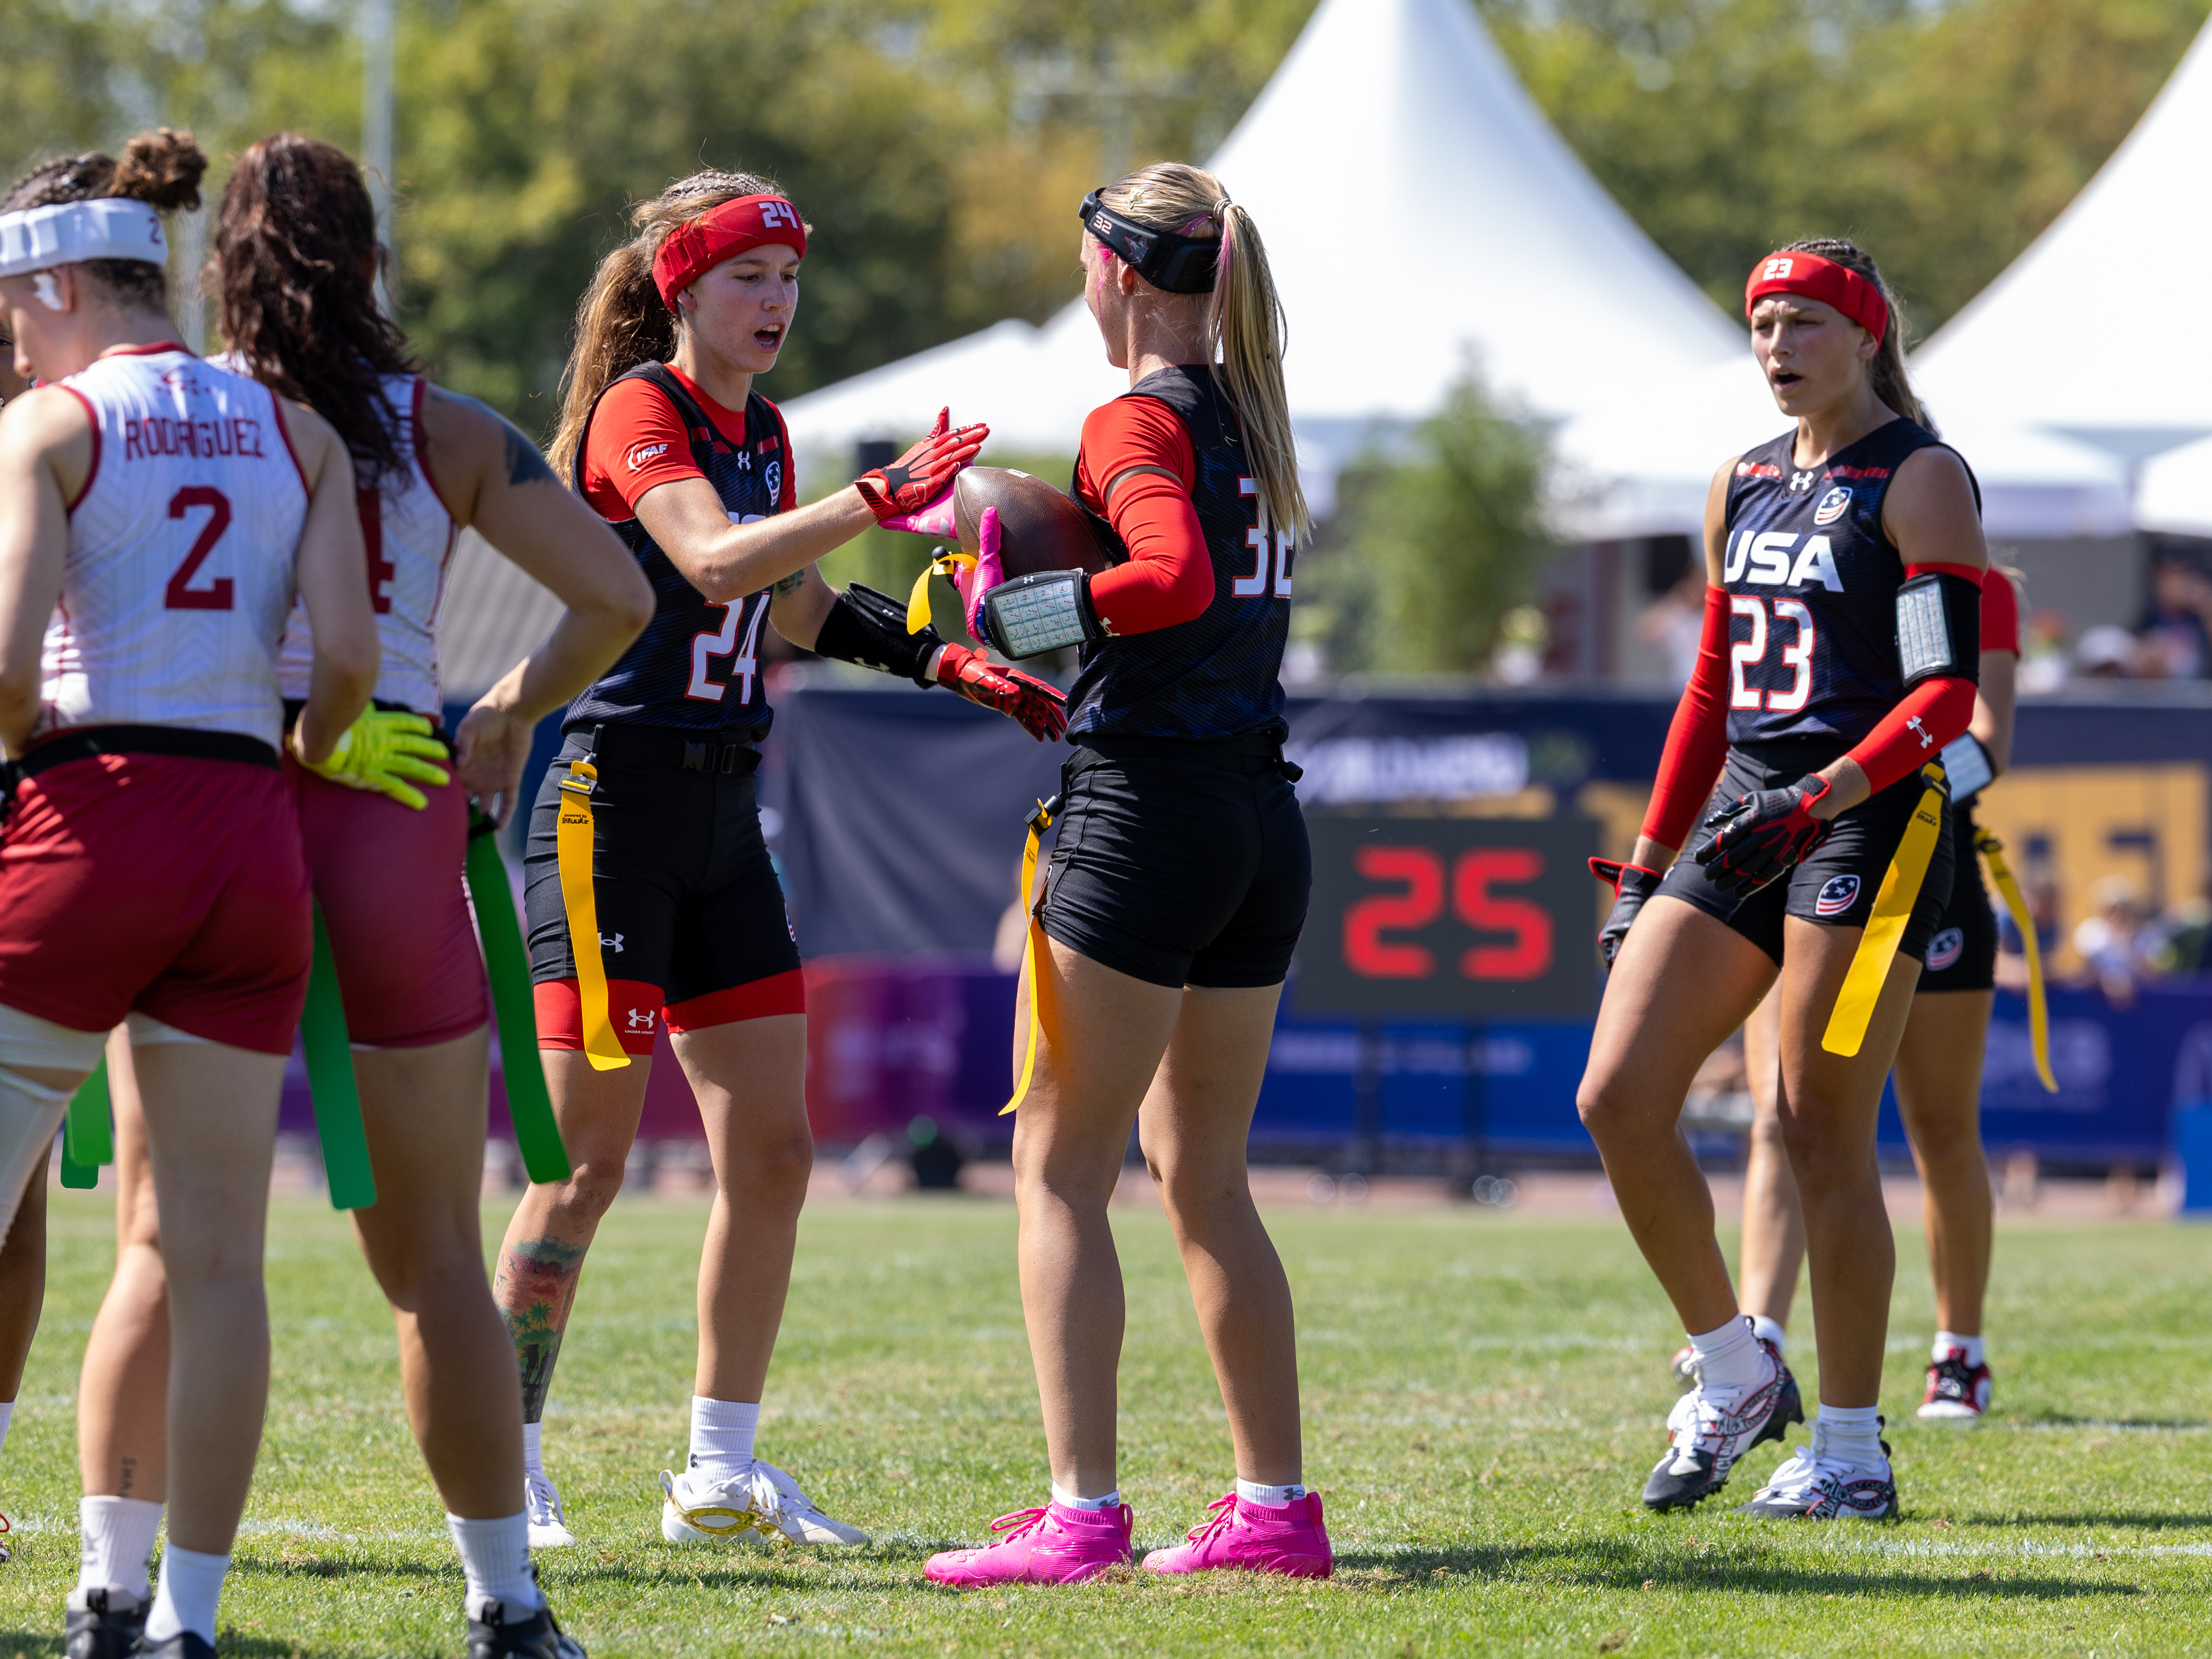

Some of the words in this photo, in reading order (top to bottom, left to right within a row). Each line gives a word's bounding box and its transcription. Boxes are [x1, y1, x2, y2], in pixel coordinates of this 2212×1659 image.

[757, 202, 798, 230] 24
[1093, 215, 1112, 235] 32
[1763, 258, 1794, 281] 23
[637, 444, 668, 463] IFAF
[165, 485, 234, 610] 2
[1232, 475, 1296, 599] 32
[1723, 529, 1845, 593] USA
[684, 591, 770, 707] 24
[1729, 594, 1816, 713] 23
[1344, 845, 1553, 982] 25
